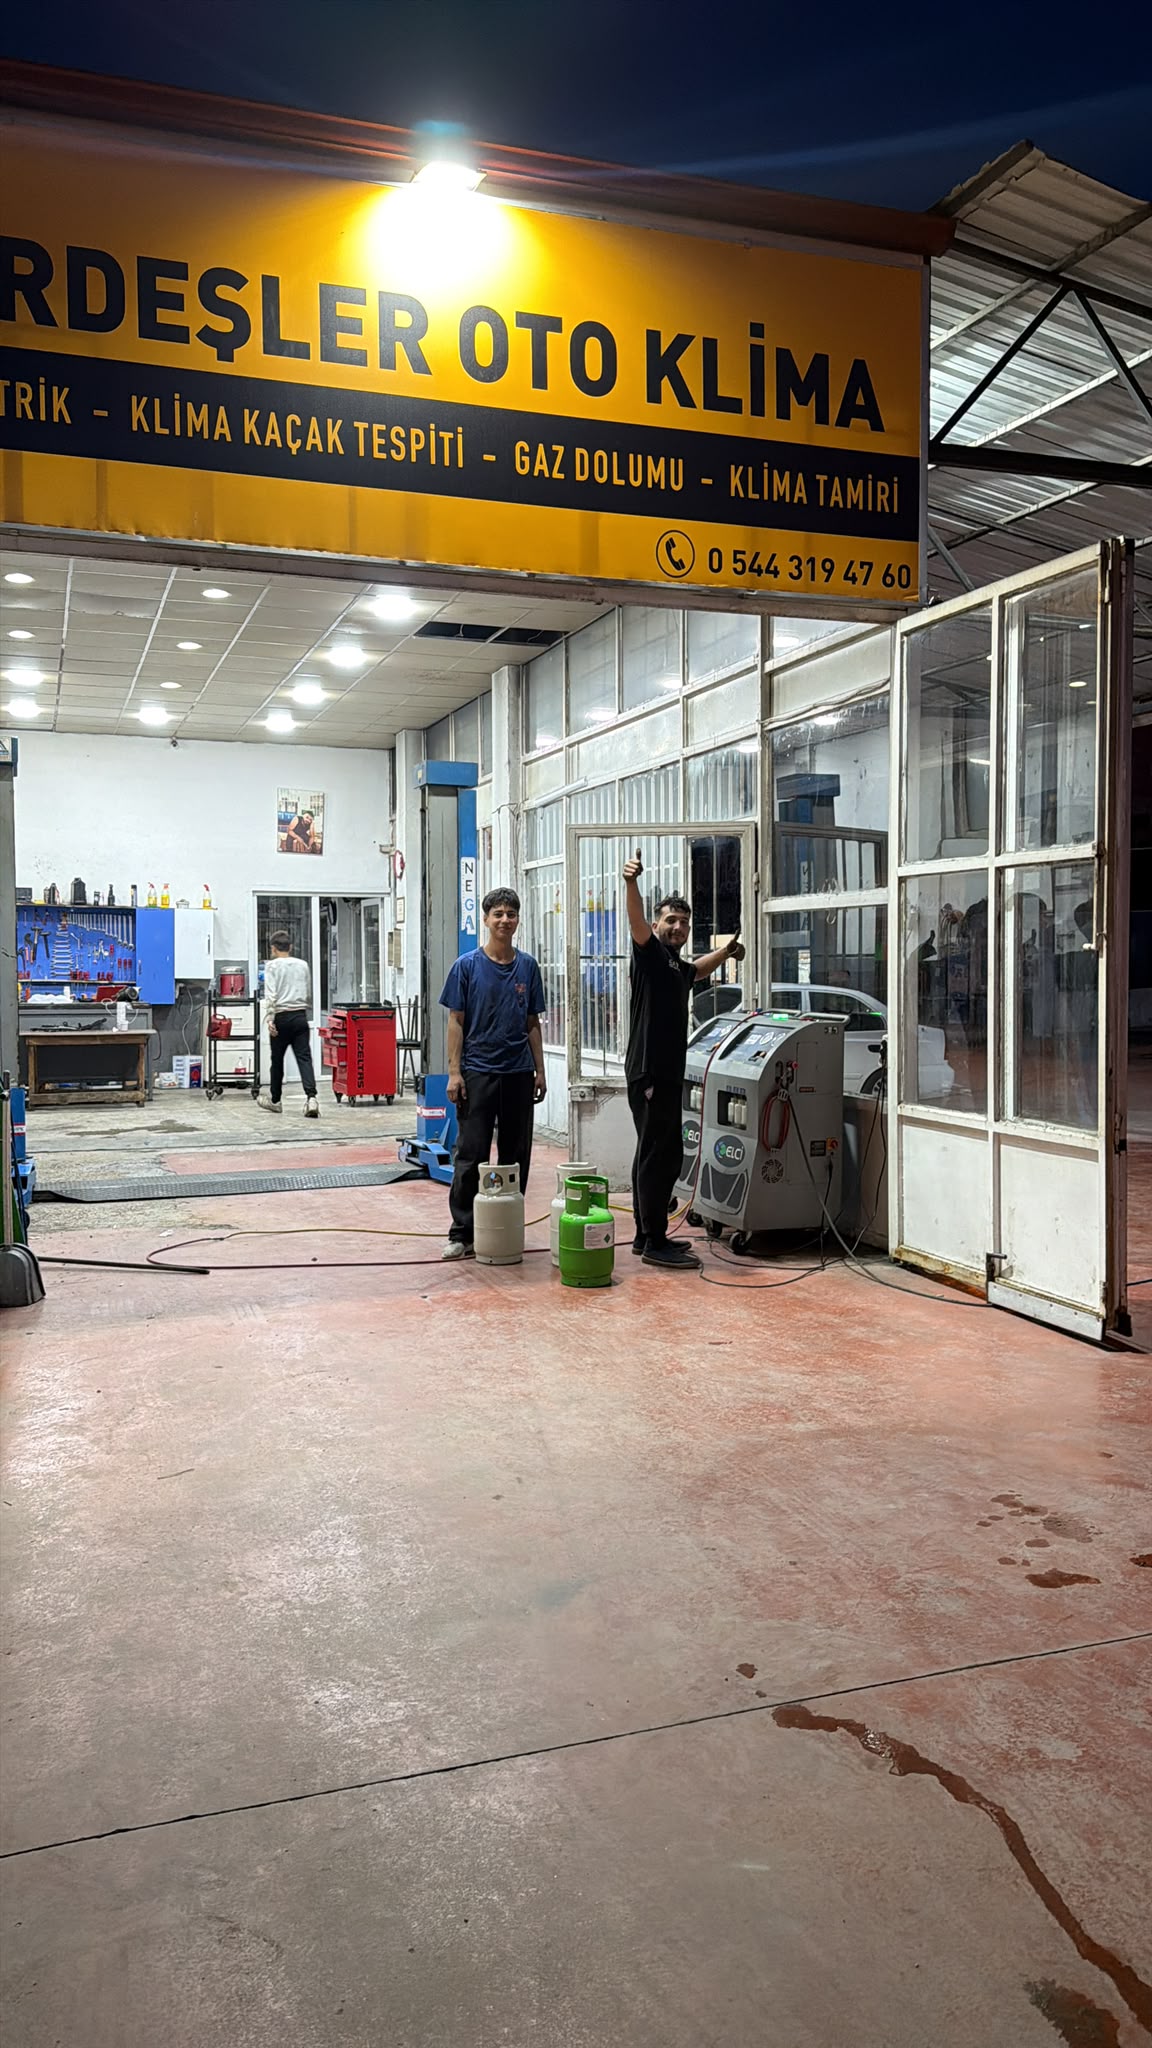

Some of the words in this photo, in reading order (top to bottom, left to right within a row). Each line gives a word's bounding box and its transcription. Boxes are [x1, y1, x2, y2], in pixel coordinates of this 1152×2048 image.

[0, 235, 433, 376] RDEŞLER
[459, 305, 617, 397] OTO
[646, 321, 885, 432] KLİMA
[131, 393, 232, 442] KLİMA
[244, 408, 344, 455] KAÇAK
[354, 422, 464, 469] TESPİTİ
[514, 441, 565, 480] GAZ
[575, 448, 684, 491] DOLUMU
[730, 461, 807, 506] KLİMA
[816, 474, 899, 514] TAMİRİ
[708, 548, 723, 573] 0
[732, 550, 780, 578] 544
[788, 555, 835, 583] 319
[843, 560, 874, 586] 47
[881, 563, 911, 589] 60
[464, 862, 475, 931] NEGA
